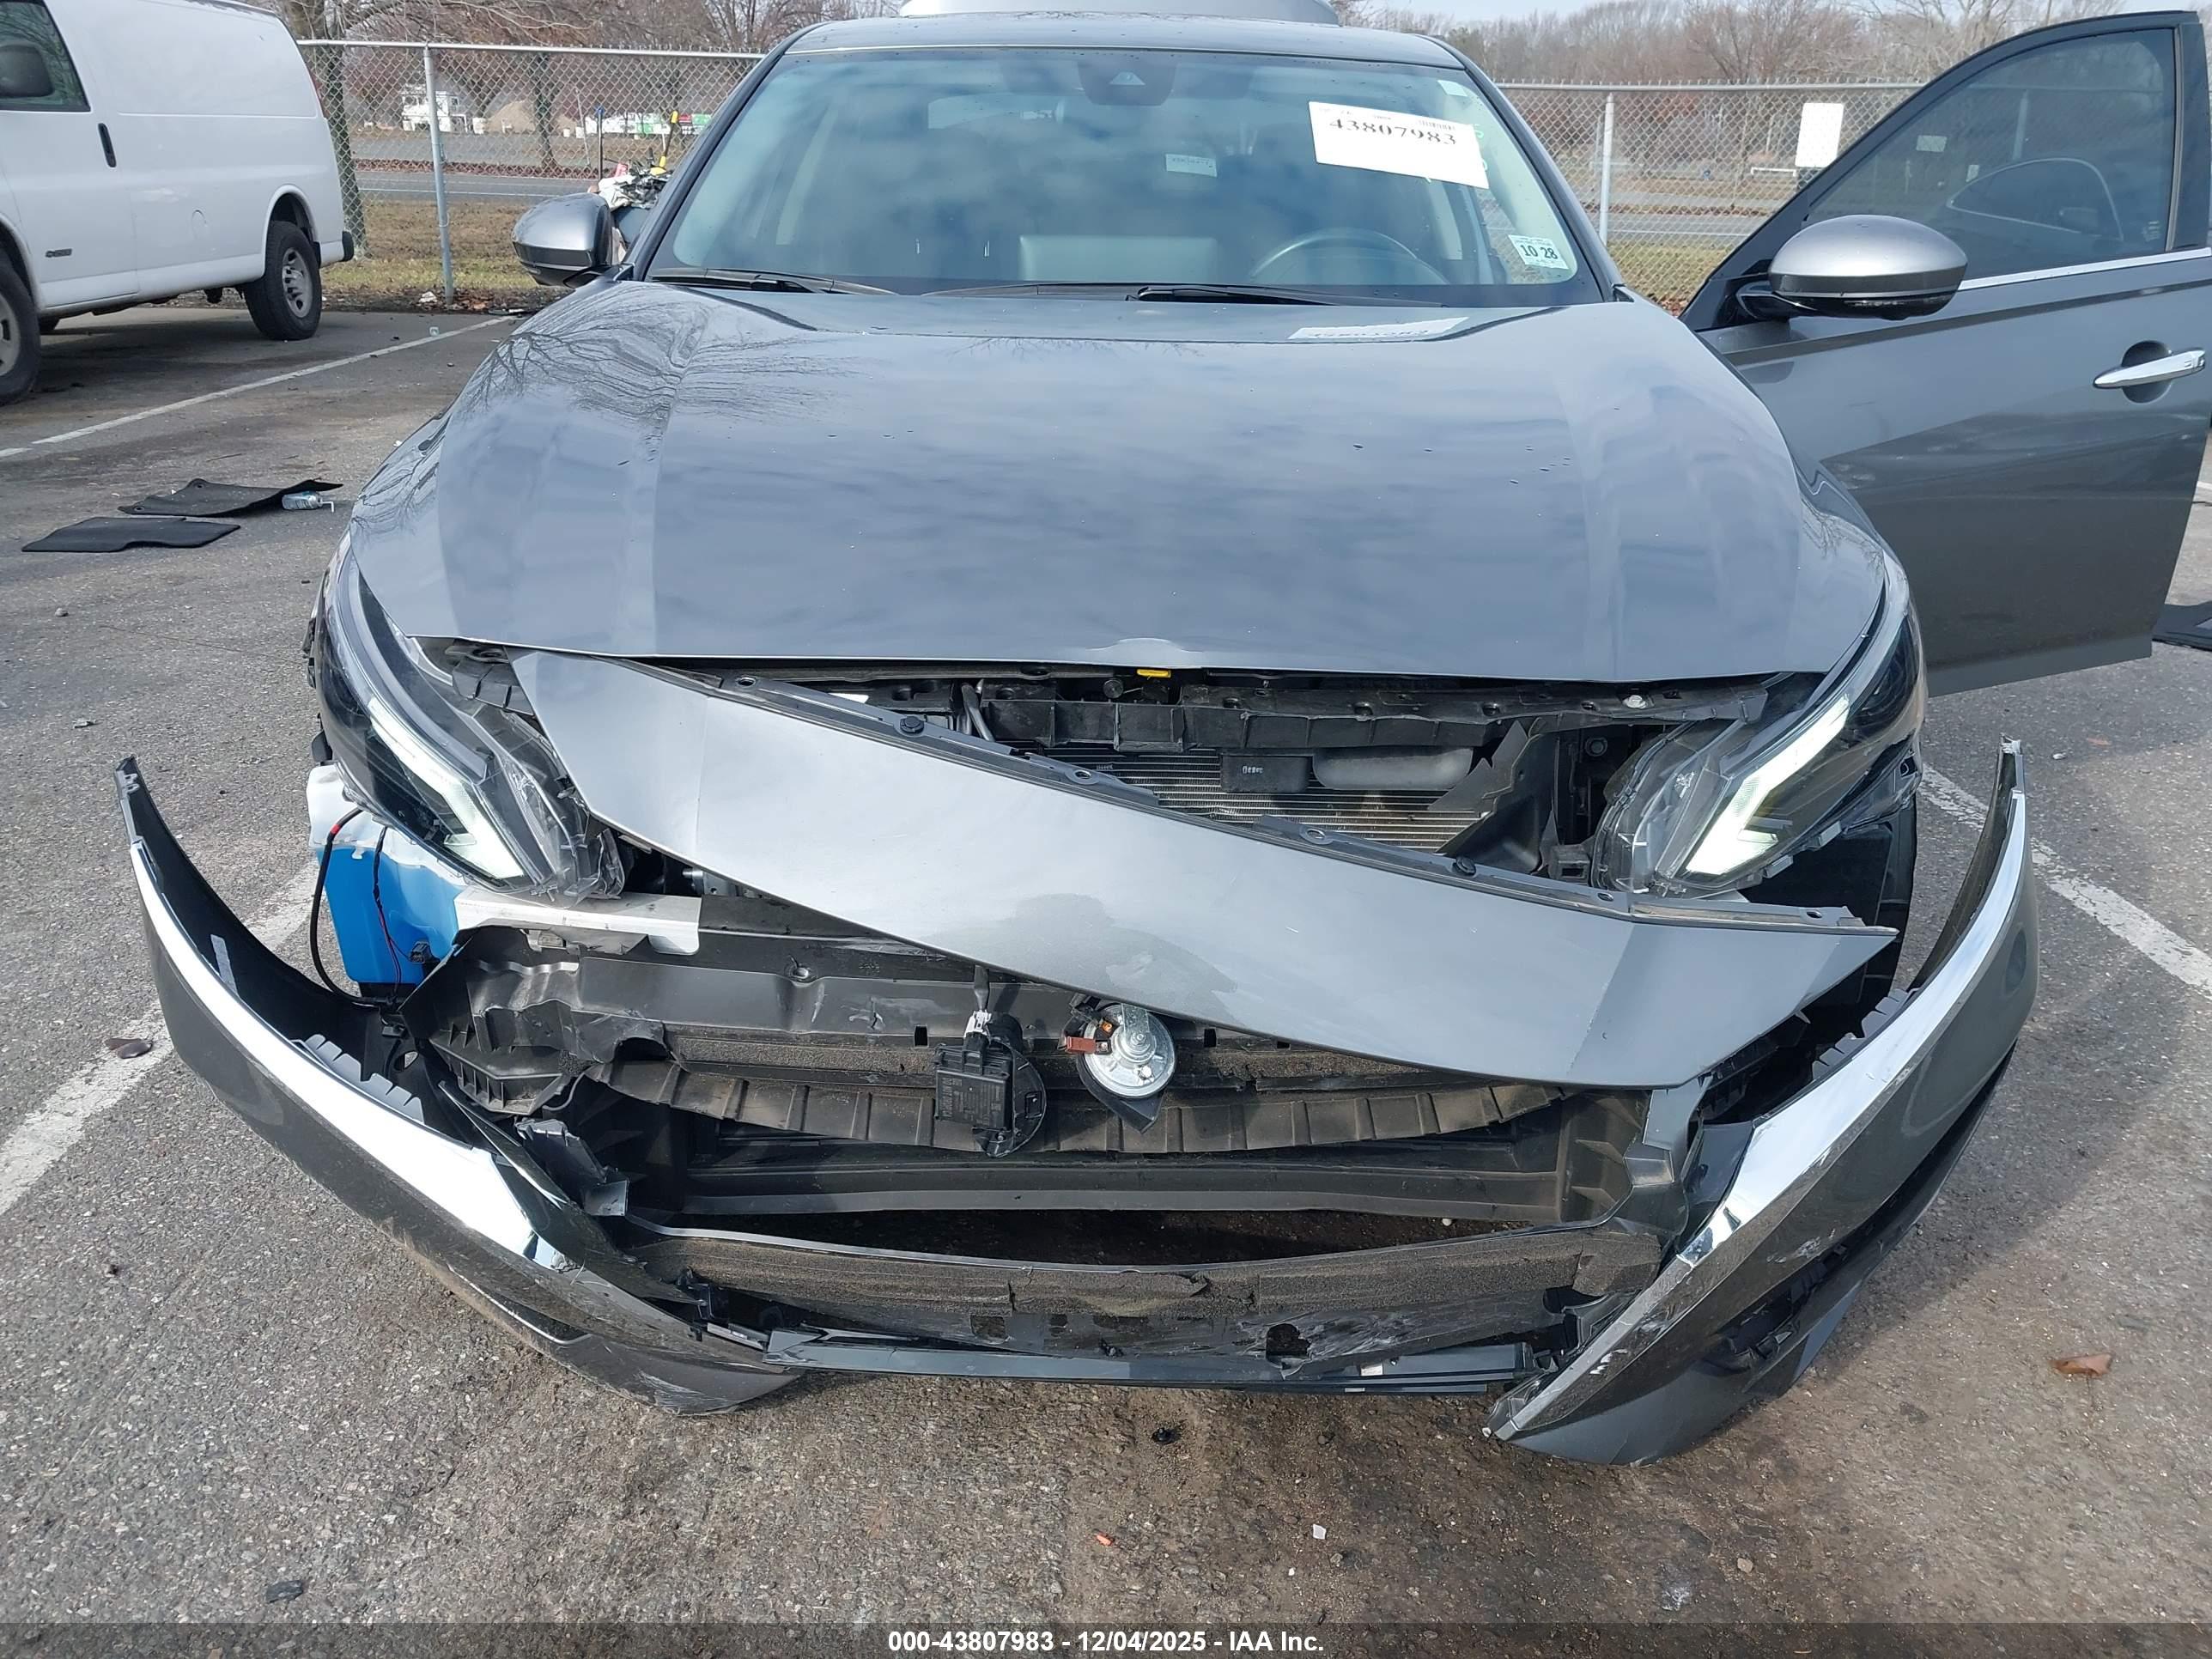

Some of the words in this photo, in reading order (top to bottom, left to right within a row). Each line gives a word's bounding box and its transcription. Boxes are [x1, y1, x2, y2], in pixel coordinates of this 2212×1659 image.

[1330, 118, 1457, 145] 43807983
[1520, 244, 1539, 258] 10
[1540, 246, 1559, 259] 28
